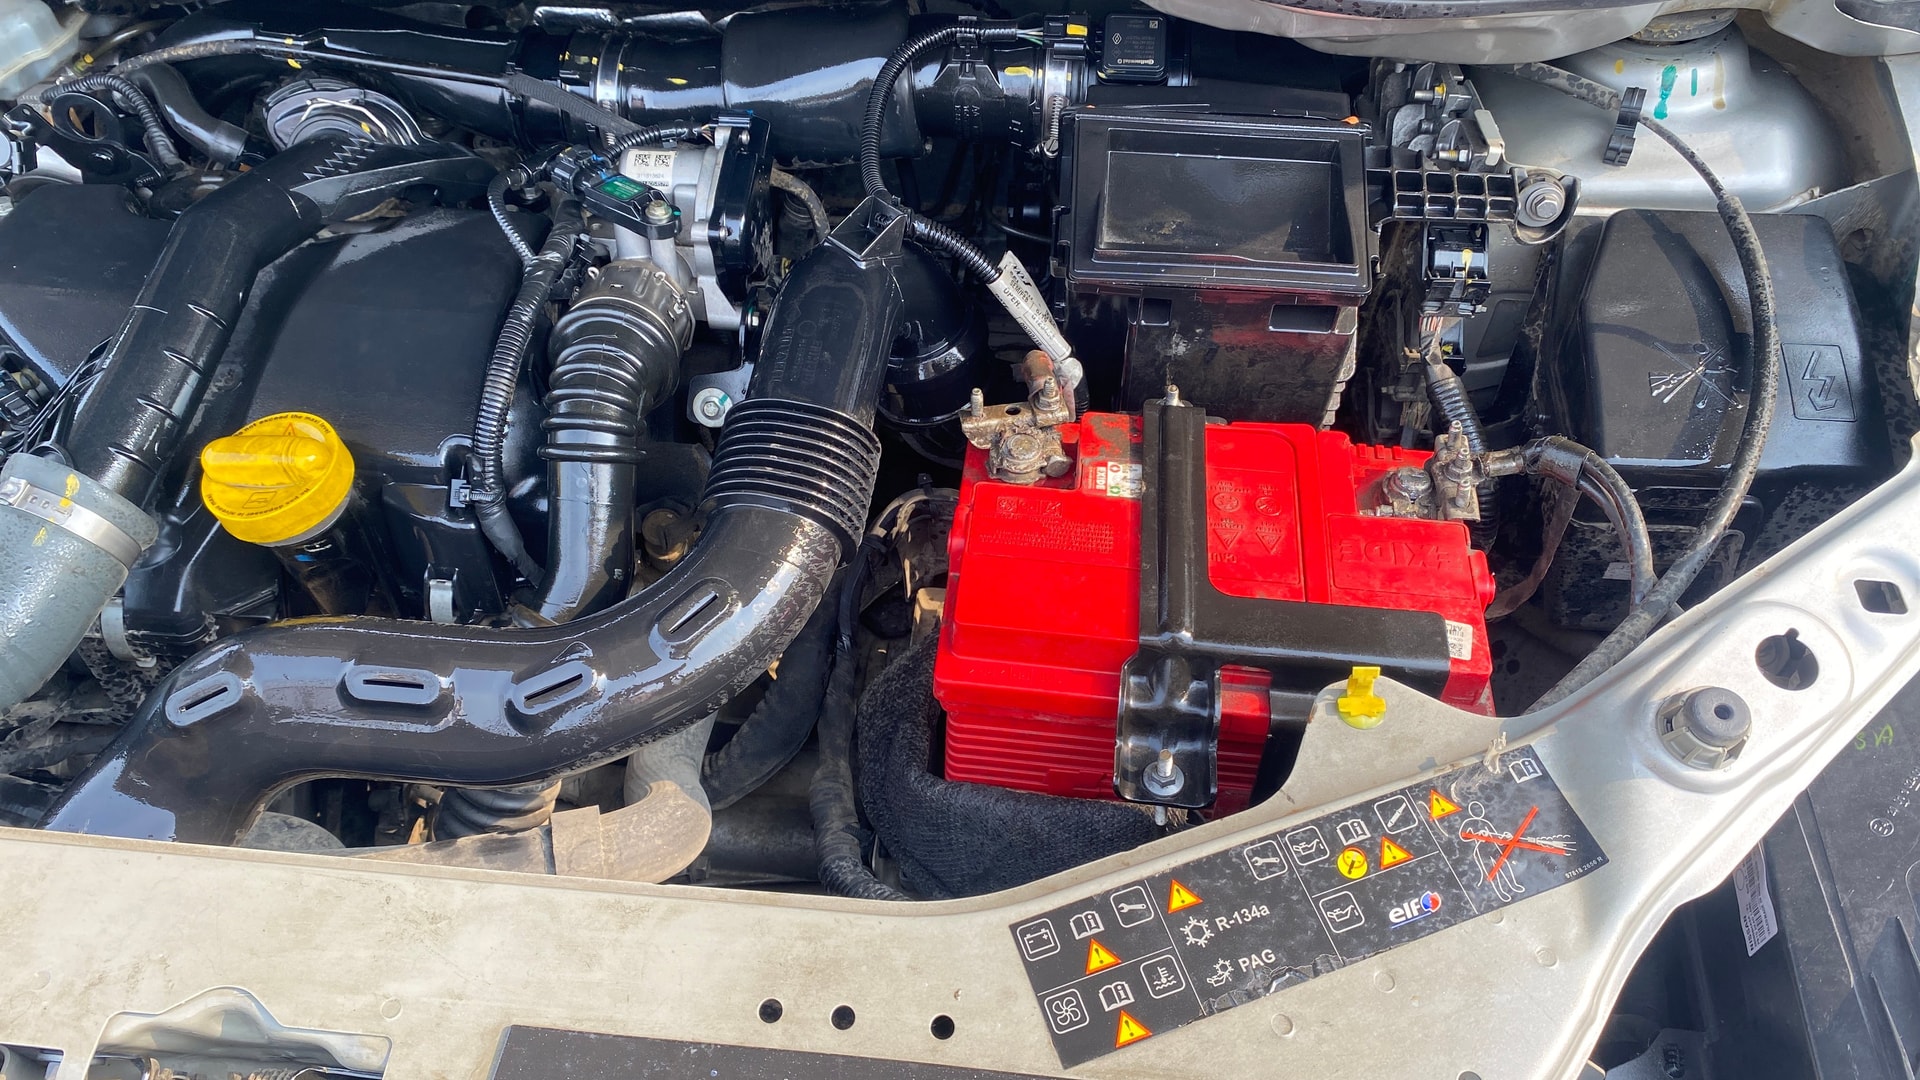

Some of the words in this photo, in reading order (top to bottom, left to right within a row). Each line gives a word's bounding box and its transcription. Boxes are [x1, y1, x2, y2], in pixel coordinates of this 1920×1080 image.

[244, 423, 257, 432] not
[259, 414, 289, 425] exceed
[1096, 466, 1107, 490] EXIDE
[1339, 540, 1459, 570] EXIDE
[1215, 904, 1271, 931] R-134a
[1388, 898, 1422, 924] elf
[1743, 915, 1754, 951] NISSAN
[1237, 949, 1277, 973] PAG
